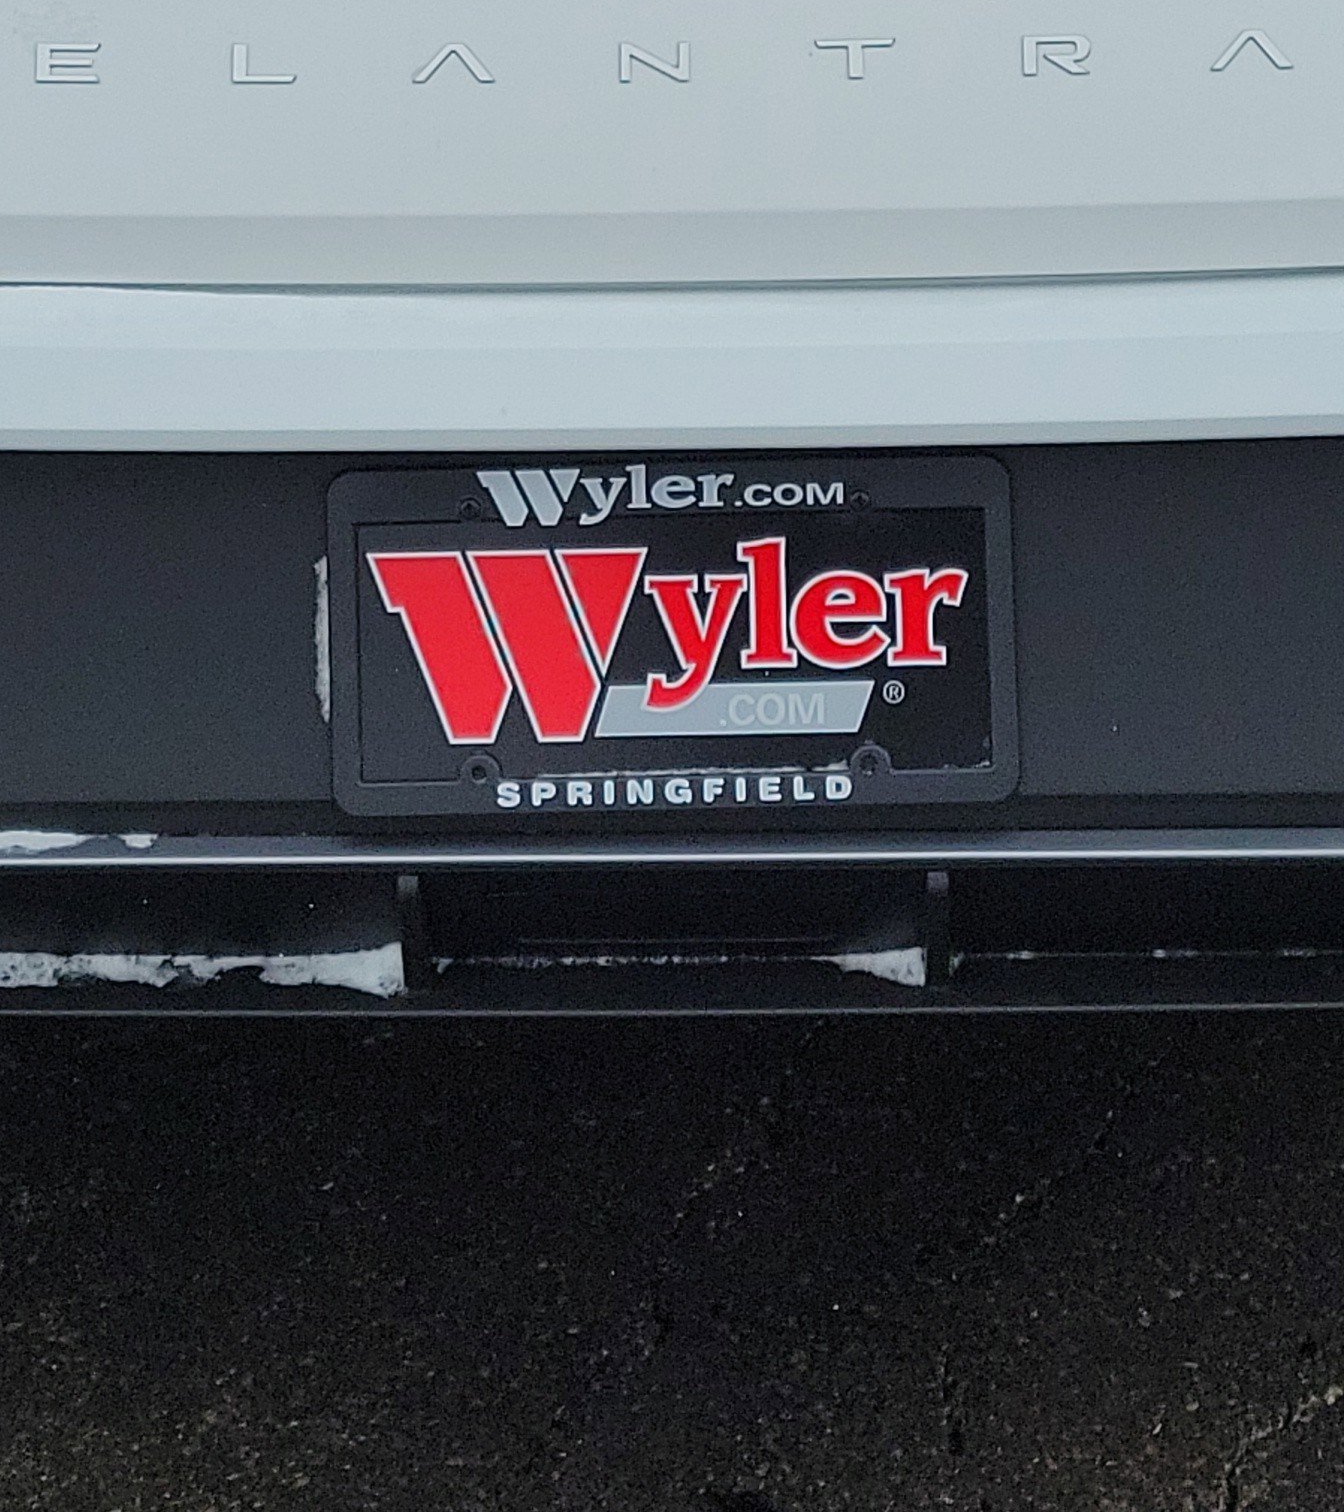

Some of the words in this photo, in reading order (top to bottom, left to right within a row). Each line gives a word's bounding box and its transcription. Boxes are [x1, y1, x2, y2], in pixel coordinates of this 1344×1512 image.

[34, 28, 1294, 85] ELANTRA
[366, 536, 969, 745] Wyler
[496, 775, 854, 809] SPRINGFIELD
